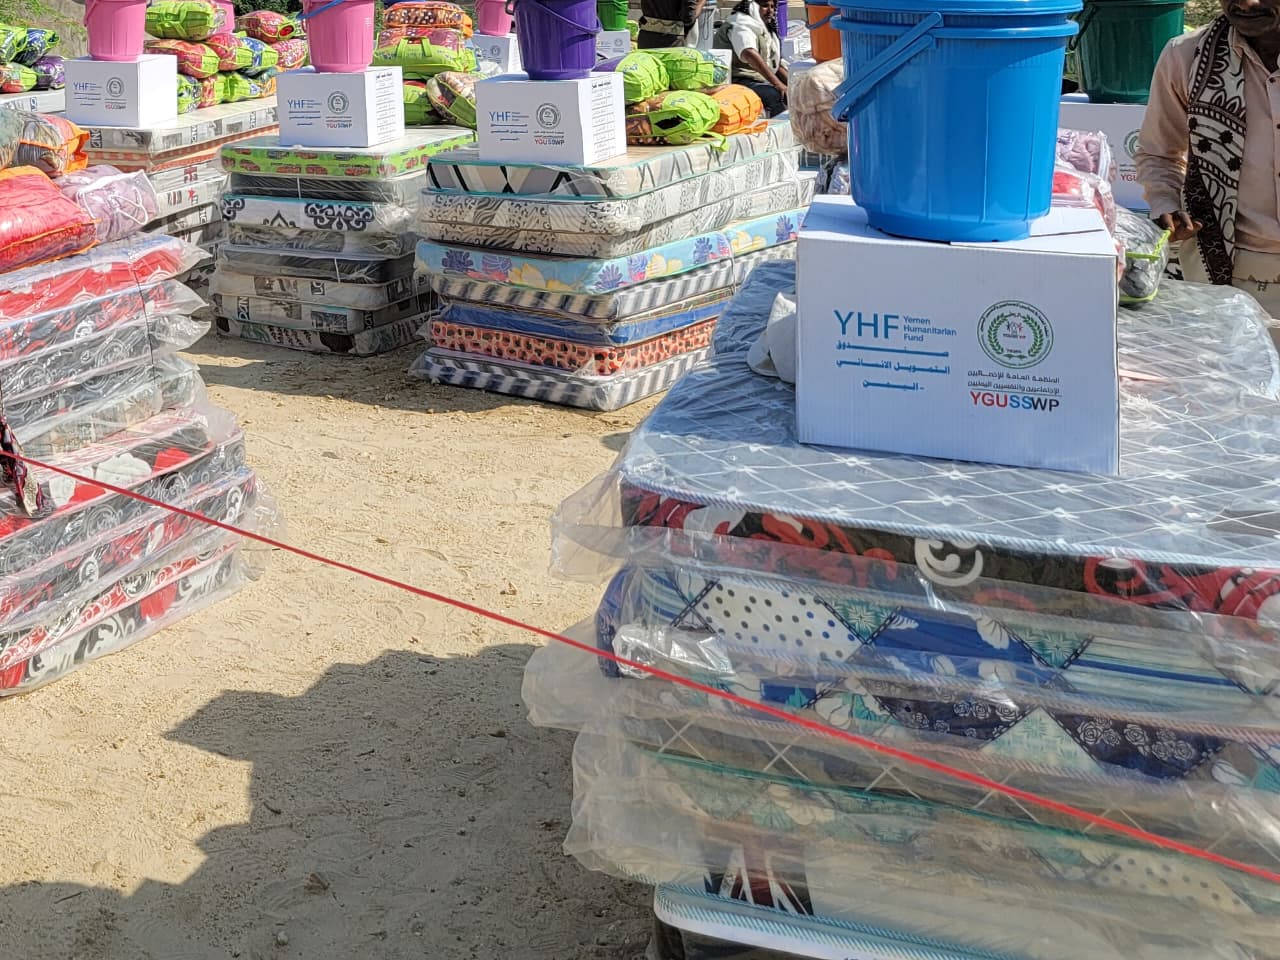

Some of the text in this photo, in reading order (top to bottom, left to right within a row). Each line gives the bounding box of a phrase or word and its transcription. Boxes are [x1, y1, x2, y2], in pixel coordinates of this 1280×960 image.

[489, 111, 511, 122] YHF
[833, 309, 900, 339] YHF
[903, 315, 931, 325] Yemen
[903, 324, 957, 336] Humanitarian
[903, 333, 924, 342] Fund
[970, 391, 1060, 412] YGUSSWP
